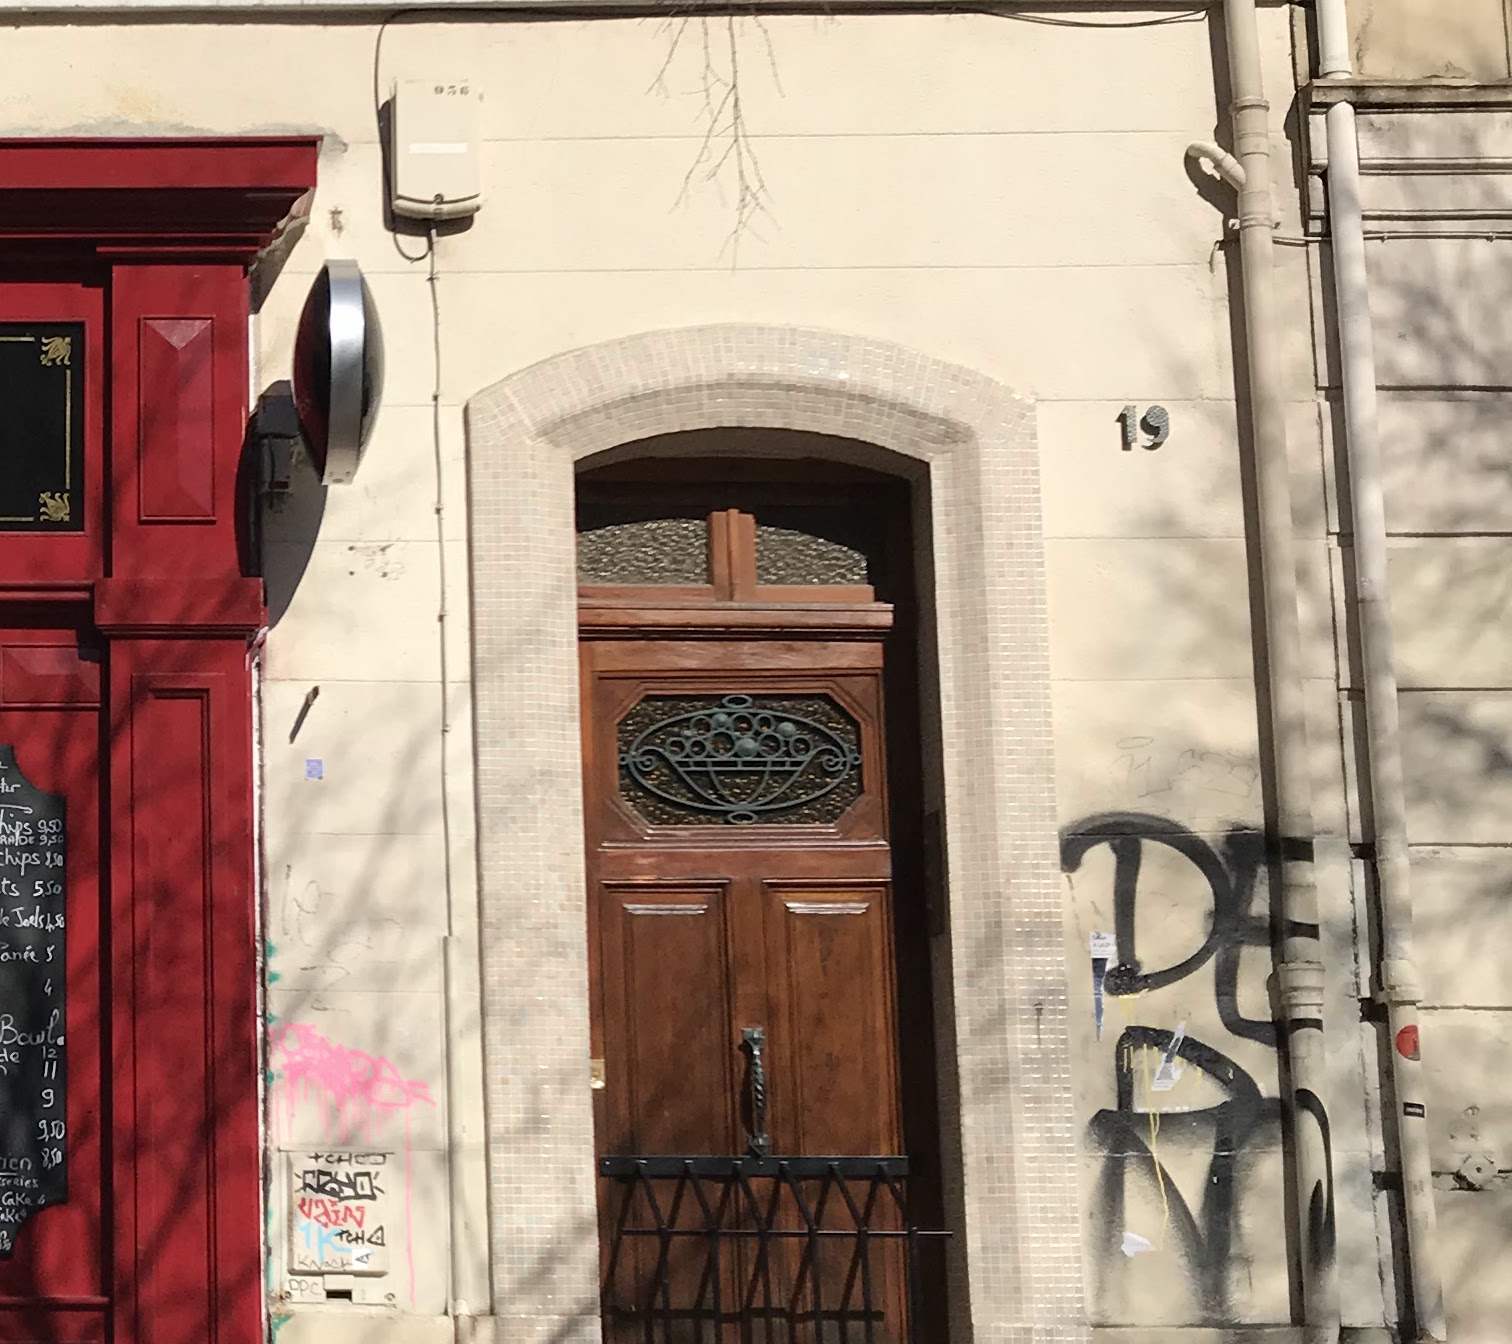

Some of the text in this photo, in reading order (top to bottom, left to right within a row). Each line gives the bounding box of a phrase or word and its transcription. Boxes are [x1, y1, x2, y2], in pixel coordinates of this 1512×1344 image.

[1117, 404, 1170, 446] 19
[44, 978, 52, 996] 4
[42, 1045, 58, 1059] 12
[43, 1060, 56, 1080] 11
[41, 1088, 54, 1108] 9
